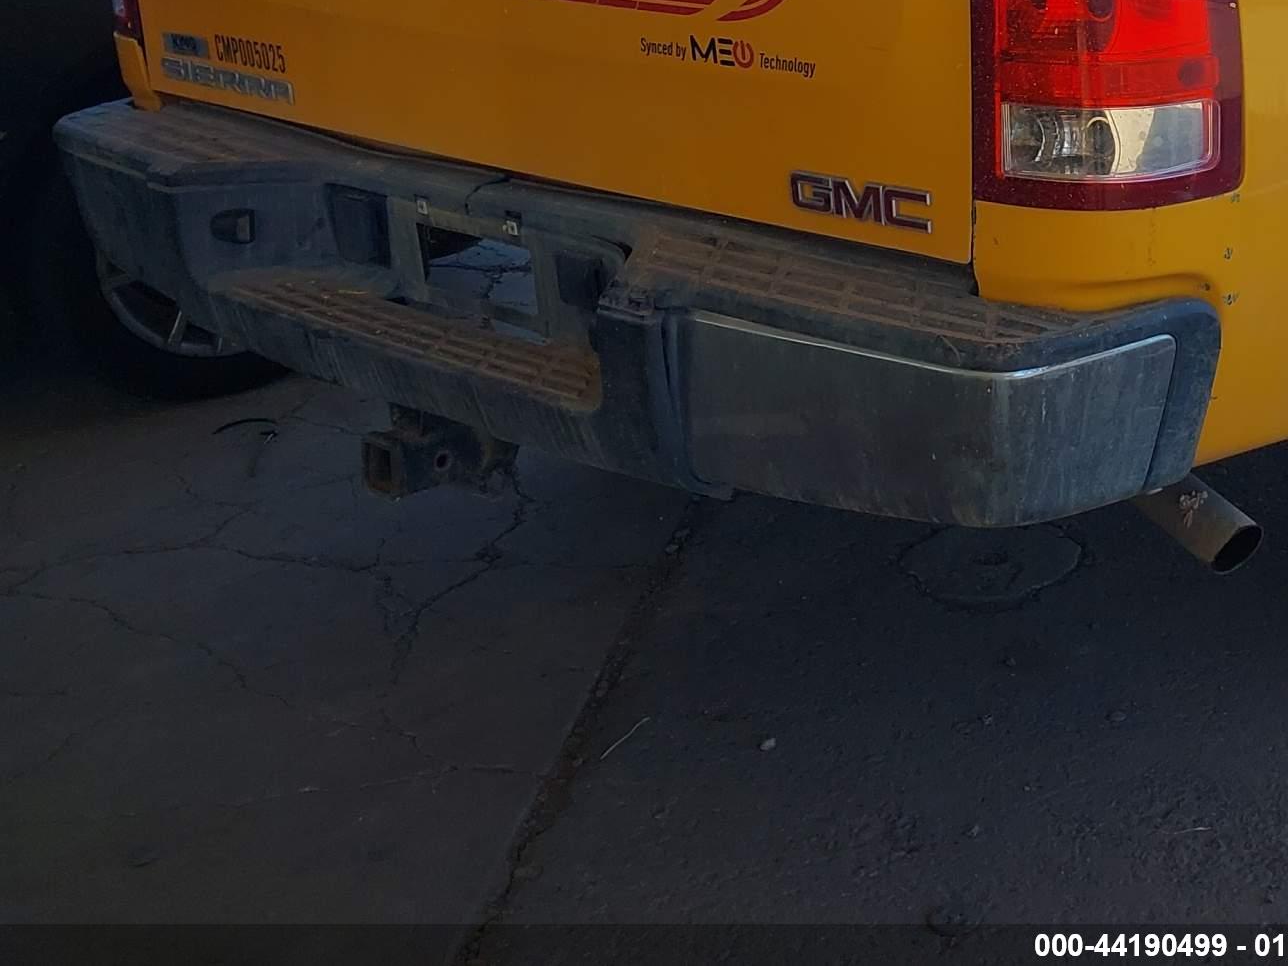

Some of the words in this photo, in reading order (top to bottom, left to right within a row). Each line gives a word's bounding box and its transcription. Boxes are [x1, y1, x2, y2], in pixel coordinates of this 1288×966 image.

[214, 33, 287, 74] CMP005025
[640, 37, 673, 56] Synced
[675, 43, 687, 61] by
[760, 52, 816, 78] Technology
[790, 169, 933, 234] GMC
